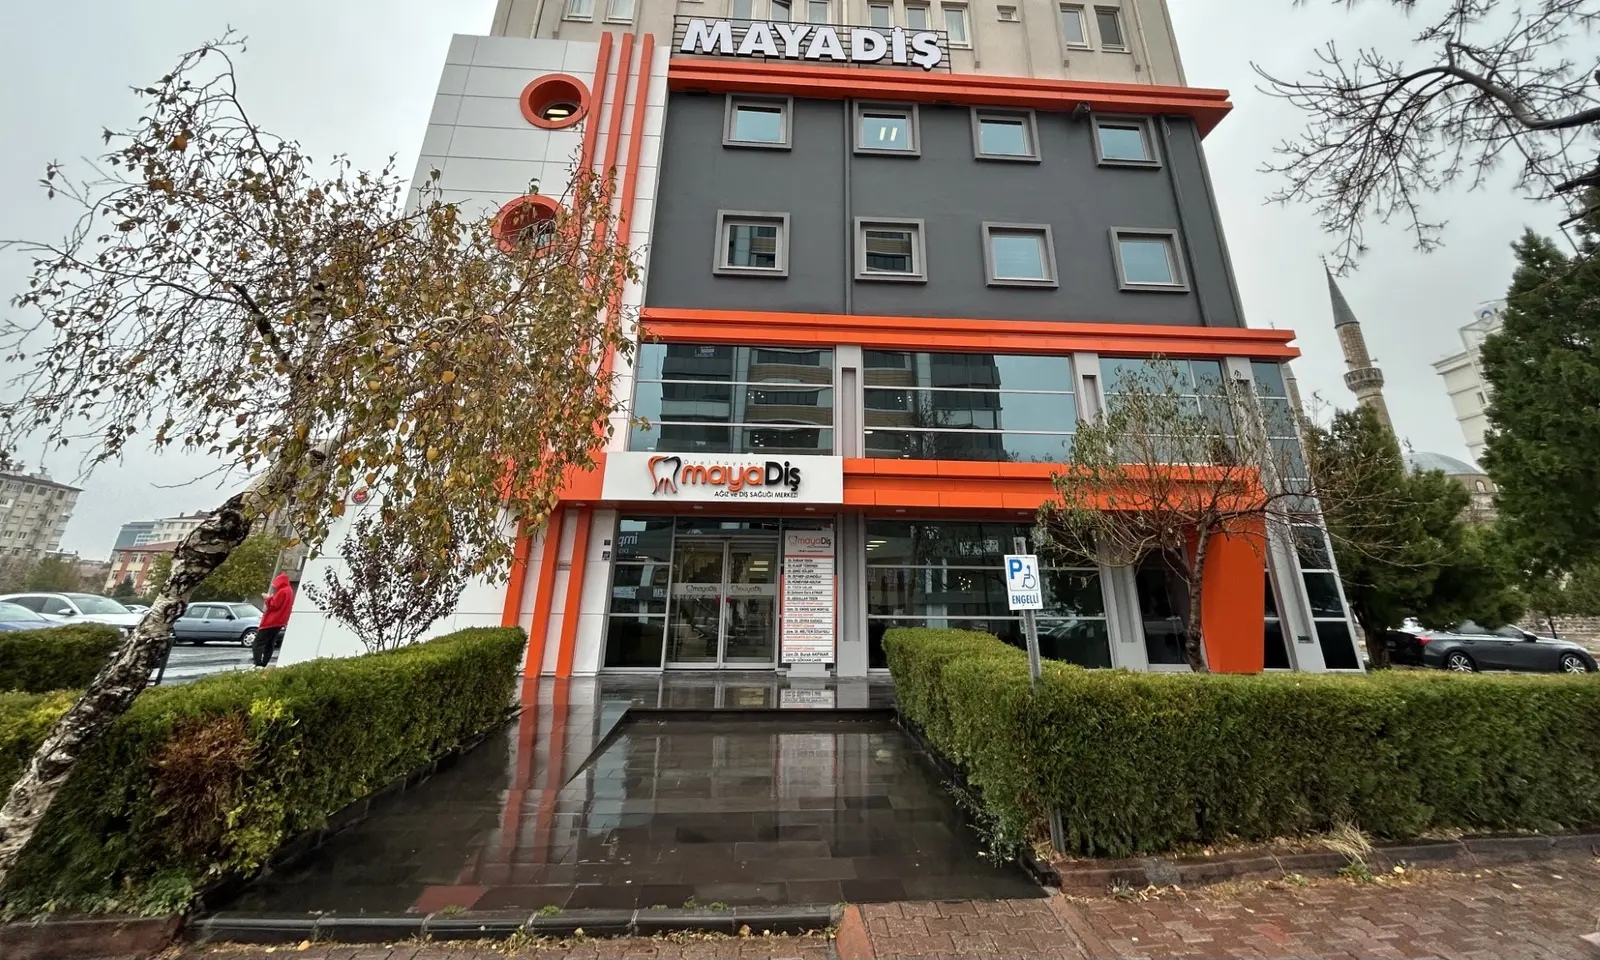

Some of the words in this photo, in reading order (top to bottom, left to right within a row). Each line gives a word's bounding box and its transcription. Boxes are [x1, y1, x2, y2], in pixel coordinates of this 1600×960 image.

[681, 461, 801, 491] mayaDiş
[714, 490, 729, 498] AĞIZ
[739, 491, 749, 499] DİŞ
[750, 491, 774, 499] SAĞLIĞI
[775, 491, 799, 499] MERKEZİ
[1009, 559, 1023, 579] P
[1012, 593, 1040, 605] ENGELLİ
